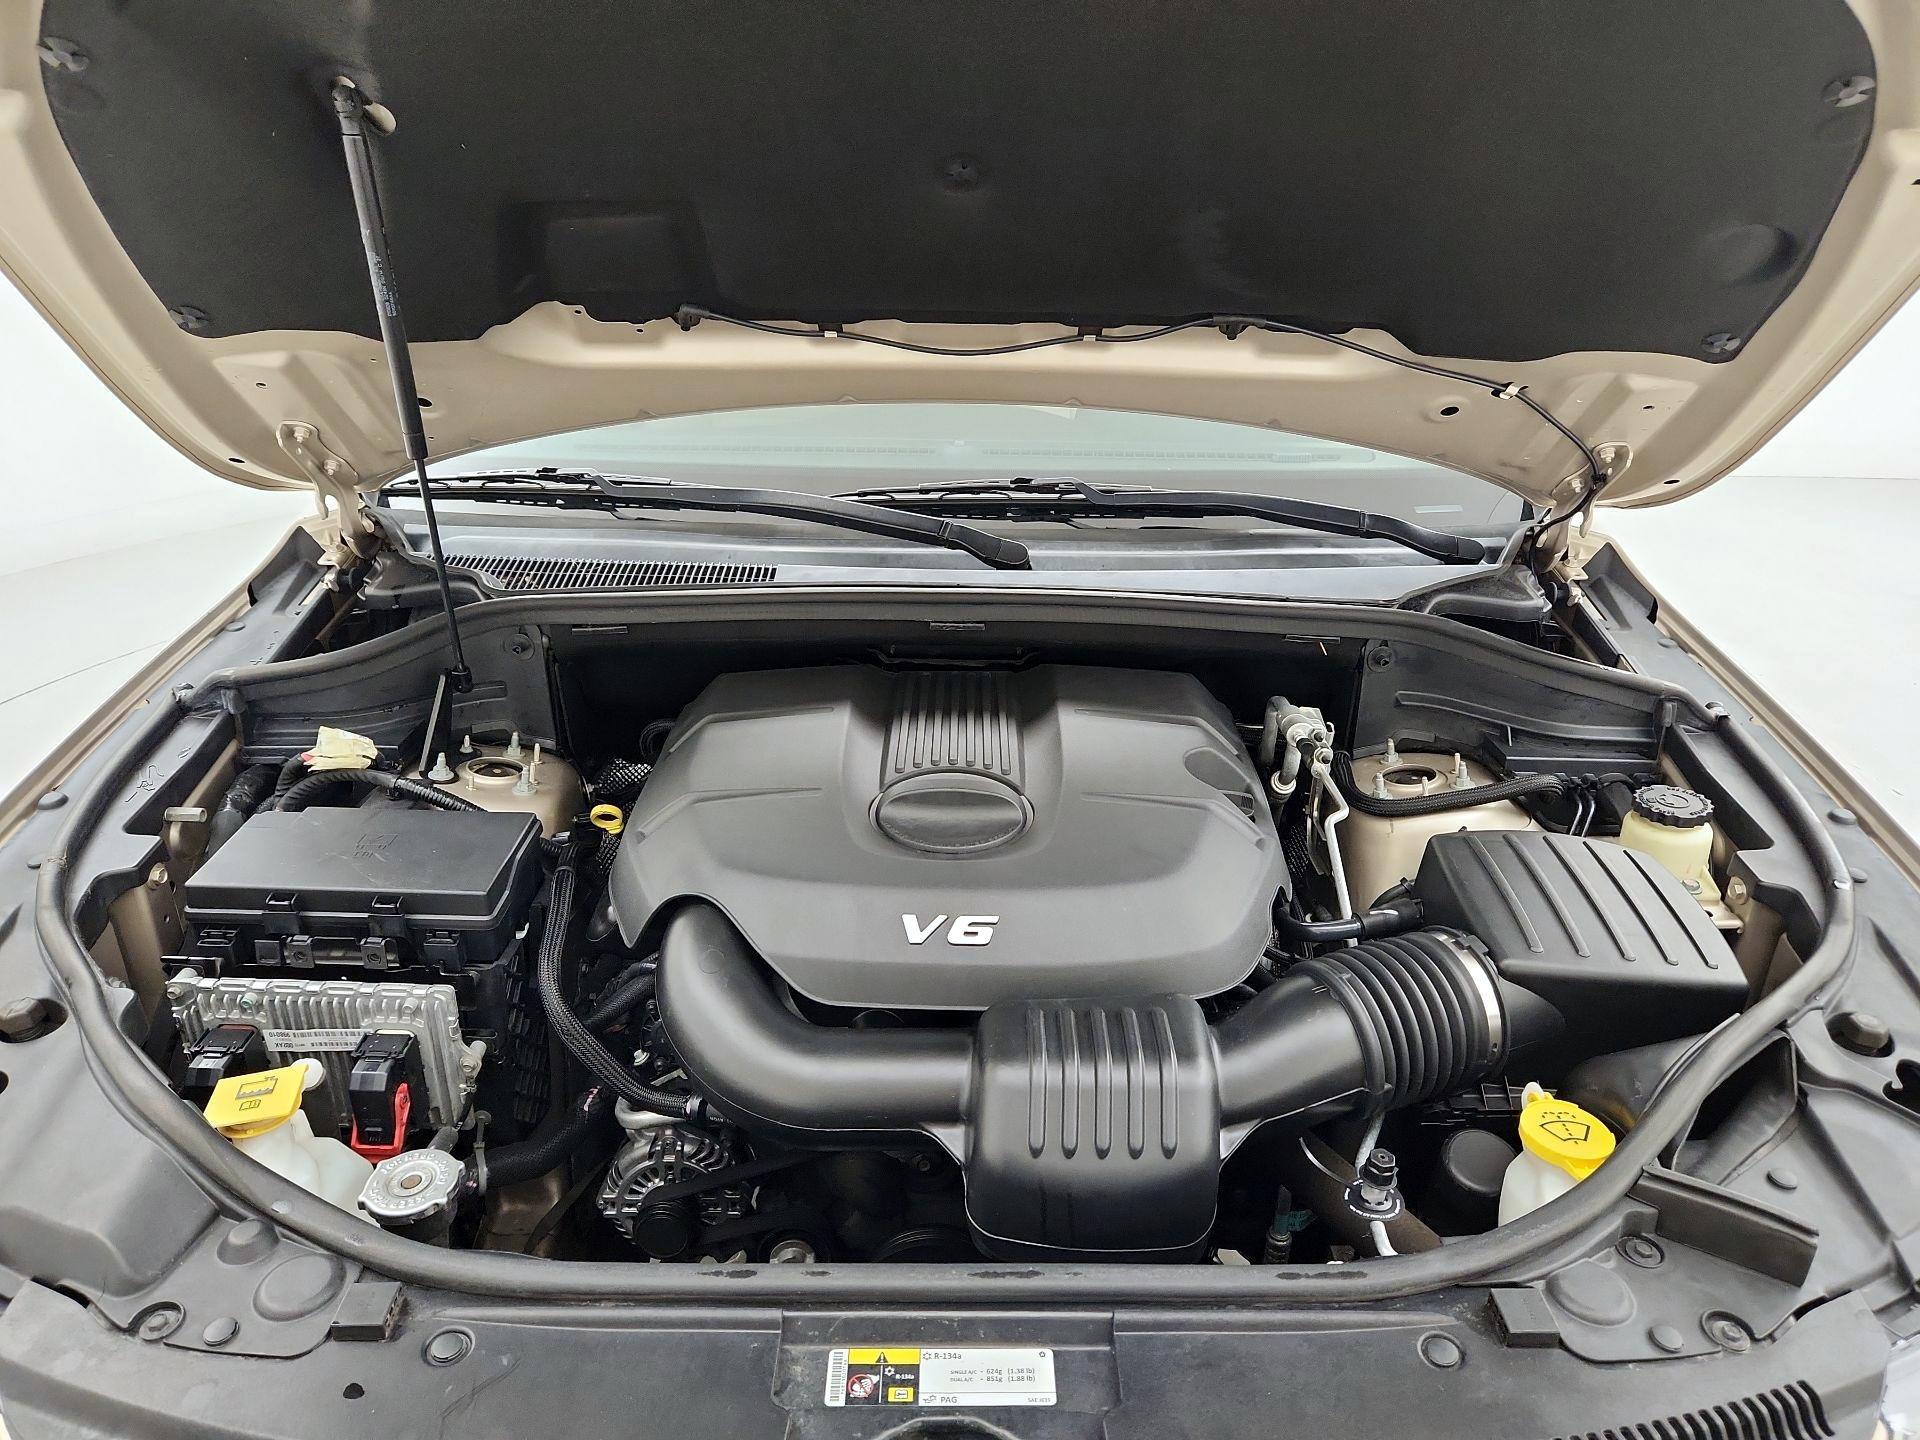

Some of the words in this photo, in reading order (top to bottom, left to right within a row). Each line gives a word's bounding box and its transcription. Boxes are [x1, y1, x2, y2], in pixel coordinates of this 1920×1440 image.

[901, 913, 1000, 946] V6
[934, 1352, 962, 1360] R-134a
[986, 1368, 1003, 1376] 624g
[986, 1375, 1003, 1383] 851g
[940, 1396, 958, 1404] PAG
